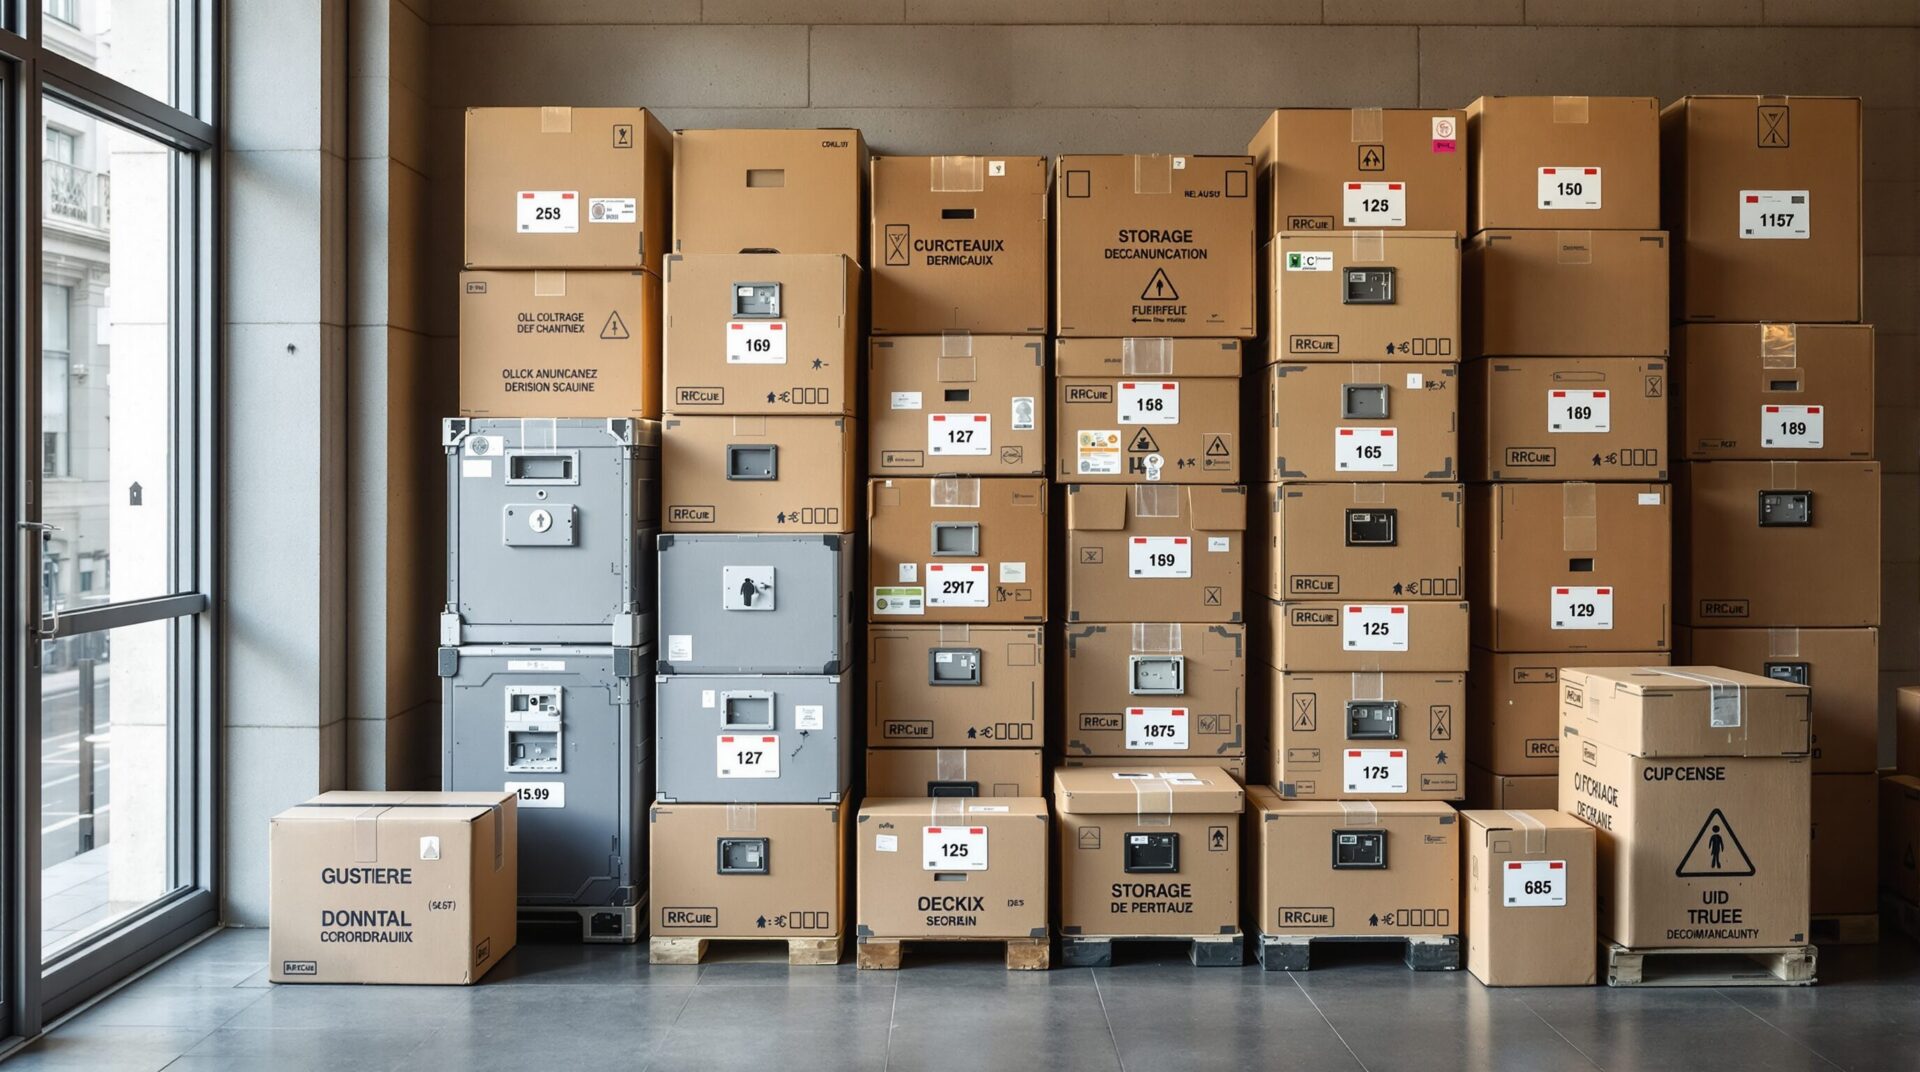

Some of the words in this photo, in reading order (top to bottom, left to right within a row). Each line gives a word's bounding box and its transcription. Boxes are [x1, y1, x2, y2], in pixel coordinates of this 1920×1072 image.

[1557, 183, 1582, 195] 150
[1363, 199, 1389, 212] 125
[1760, 214, 1794, 227] 1157
[1119, 230, 1193, 243] STORAGE
[914, 239, 1004, 252] CURCTEAUIX
[518, 313, 534, 322] OLL
[537, 313, 584, 322] COLTRAGE
[517, 324, 536, 333] DEF
[746, 339, 770, 351] 169
[502, 369, 533, 379] OLLCK
[504, 382, 550, 392] DERISION
[1567, 407, 1591, 419] 189
[1781, 422, 1806, 435] 189
[948, 430, 973, 443] 127
[1356, 446, 1381, 458] 165
[943, 581, 974, 593] 2917
[1569, 604, 1594, 617] 129
[1363, 623, 1389, 636] 125
[1144, 725, 1175, 737] 1875
[737, 752, 763, 764] 127
[517, 788, 549, 800] 15.99
[942, 844, 968, 857] 125
[322, 868, 412, 884] GUSTIERE
[1112, 884, 1191, 898] STORAGE
[1525, 881, 1552, 894] 685
[918, 897, 984, 911] DECKIX
[1703, 891, 1729, 904] UID
[1111, 902, 1127, 913] DE
[322, 910, 412, 927] DONNTAL
[1688, 909, 1742, 923] TRUEE
